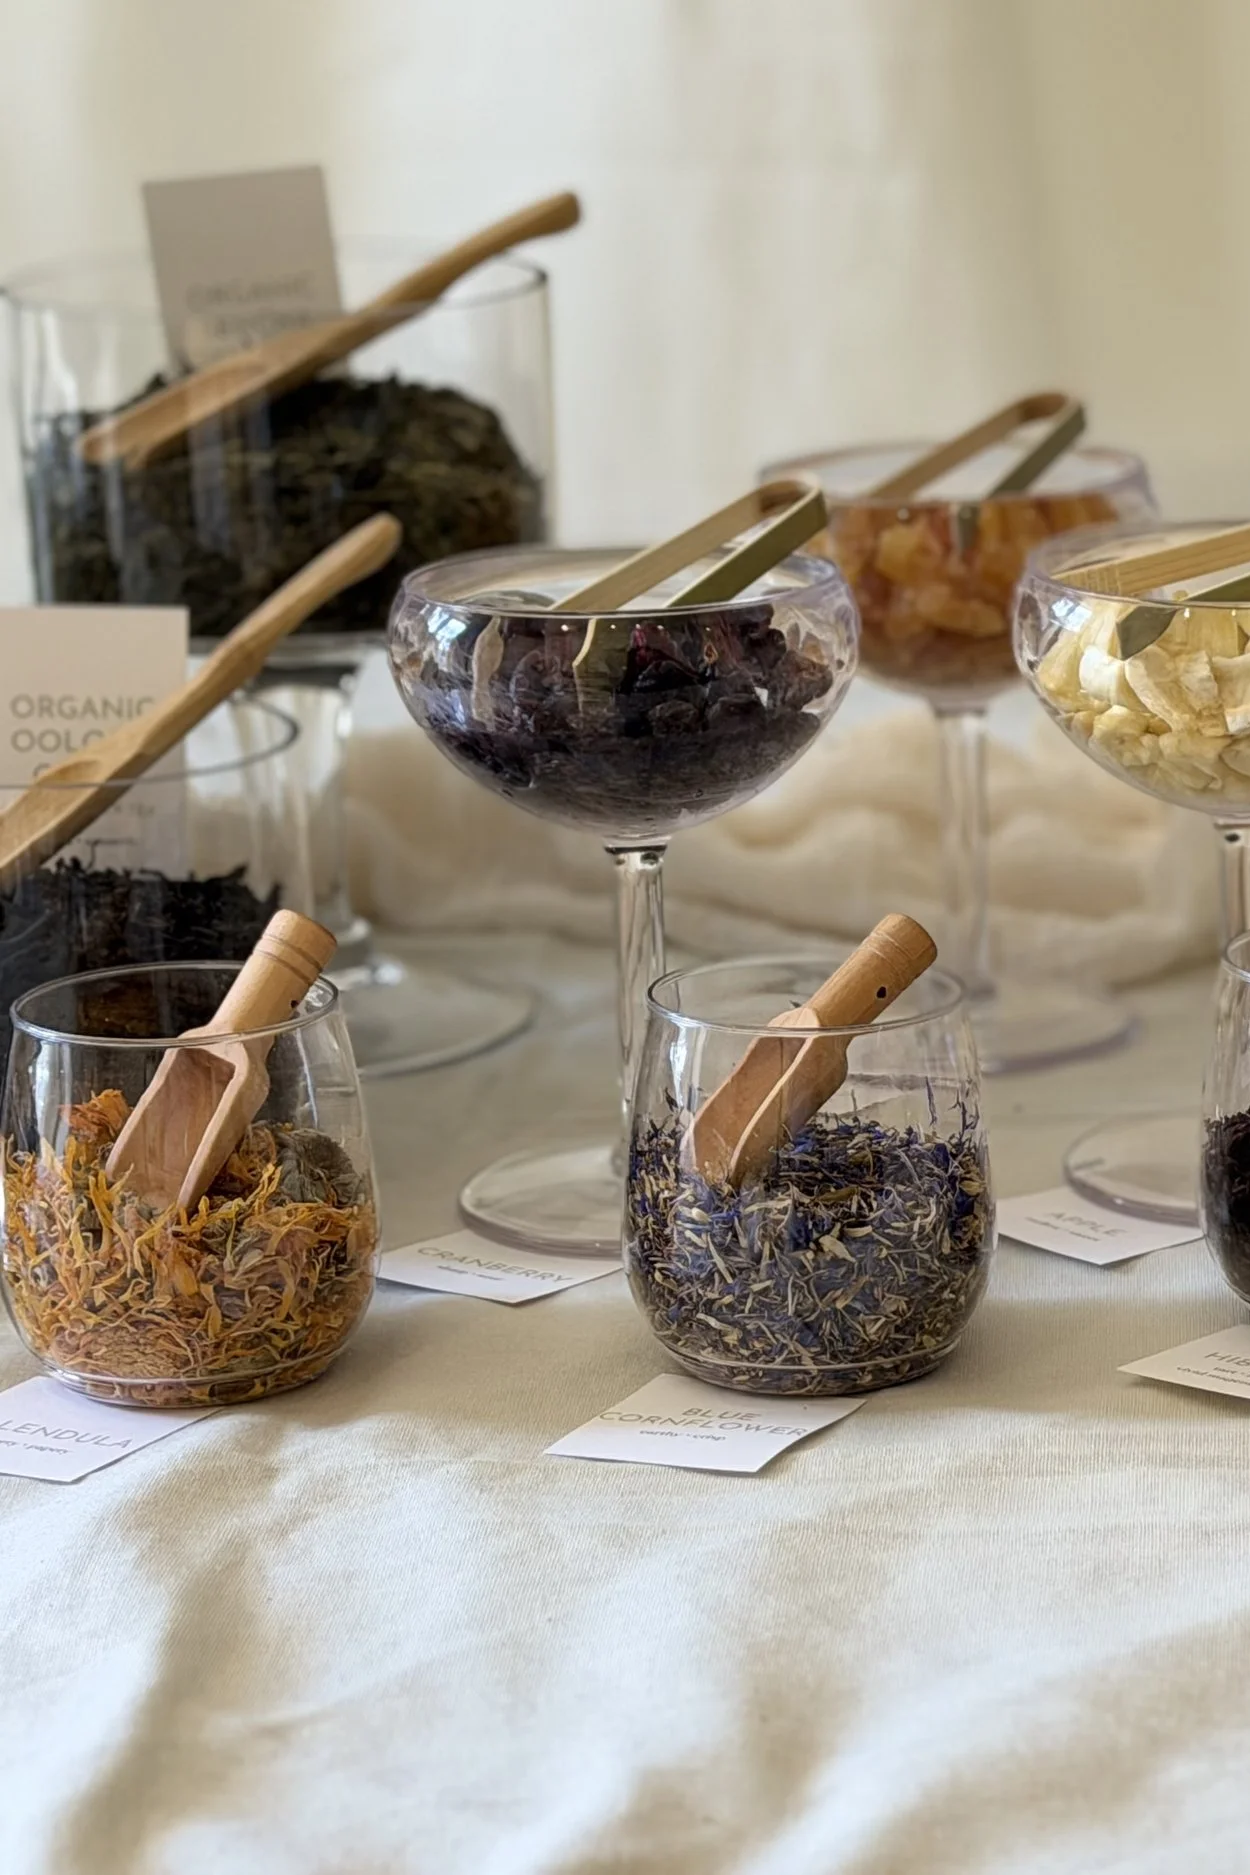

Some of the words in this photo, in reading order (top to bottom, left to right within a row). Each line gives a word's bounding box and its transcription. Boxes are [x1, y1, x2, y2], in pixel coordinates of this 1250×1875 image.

[1043, 1211, 1128, 1237] APPLE
[417, 1246, 574, 1282] CRANBERRY
[599, 1411, 808, 1436] CORNFLOWER
[682, 1407, 763, 1421] BLUE
